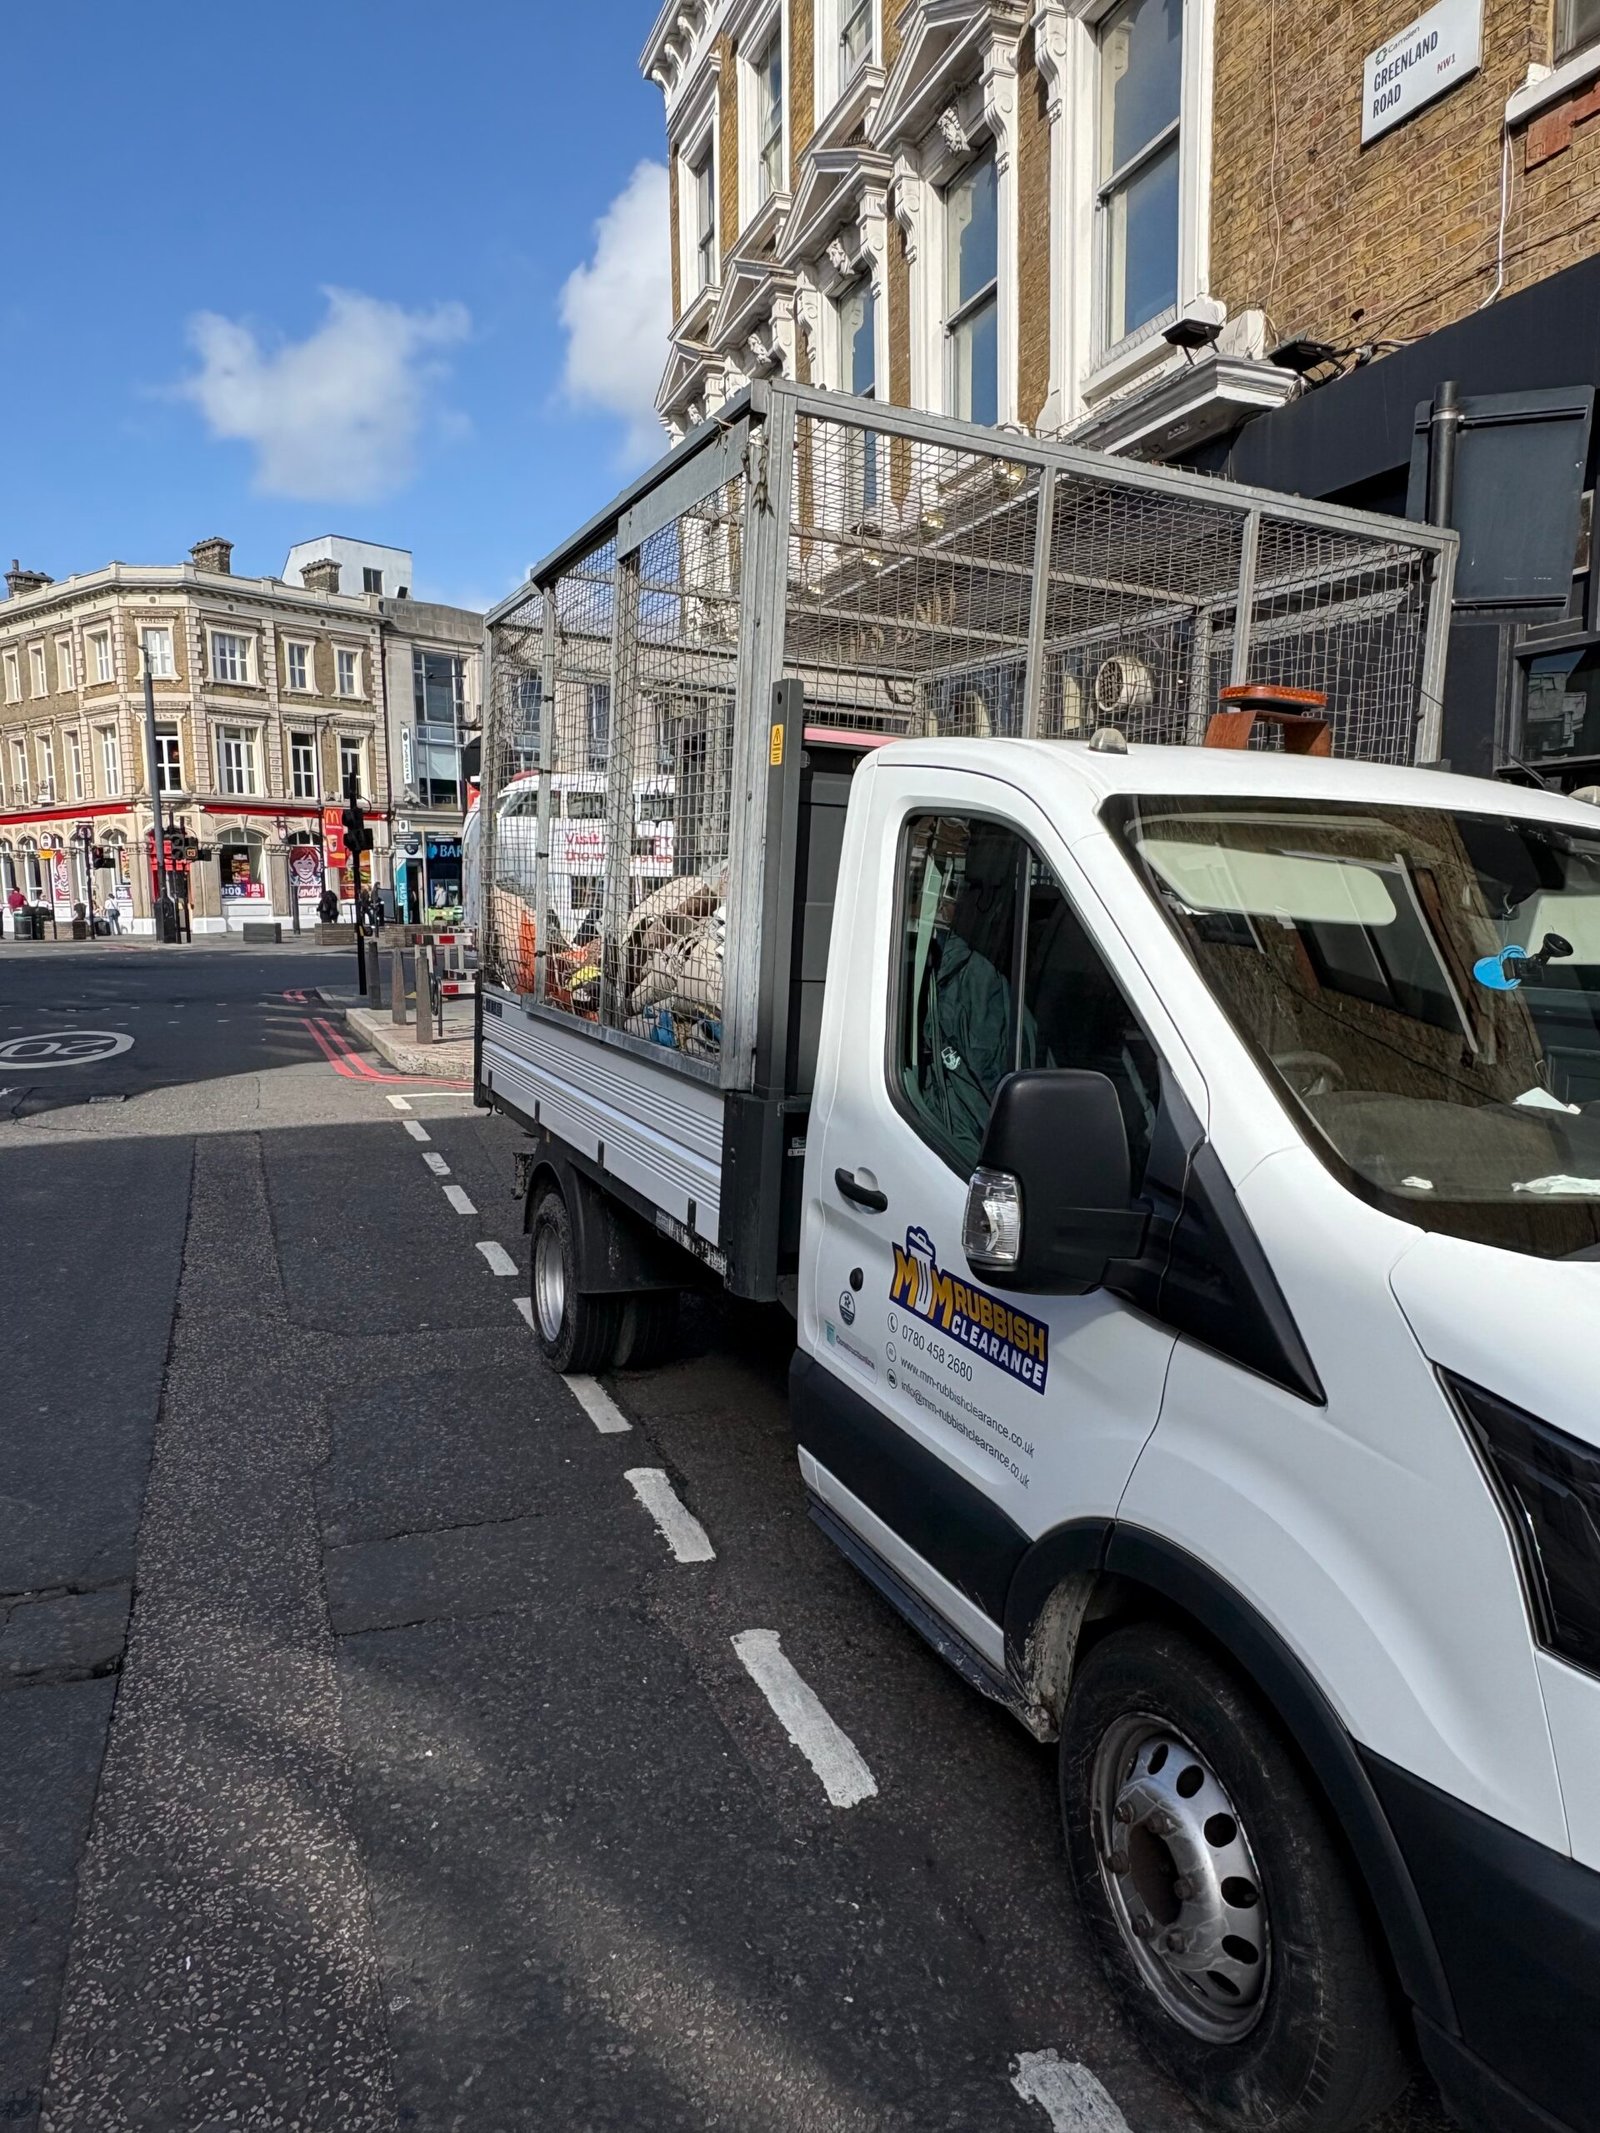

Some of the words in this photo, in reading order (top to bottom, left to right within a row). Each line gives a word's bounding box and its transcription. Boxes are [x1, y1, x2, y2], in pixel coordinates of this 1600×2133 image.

[1373, 30, 1438, 92] GREENLAND
[1388, 26, 1420, 53] Camden
[1436, 53, 1456, 74] NW1
[1373, 83, 1401, 119] ROAD
[1, 1040, 116, 1058] 20
[951, 1314, 1044, 1387] CLEARANCE
[953, 1281, 1045, 1361] RUBBISH
[902, 1325, 925, 1350] 0780
[927, 1341, 945, 1364] 458
[947, 1353, 973, 1381] 2680
[900, 1356, 1035, 1459] www.mm-rubbishclearance.co.uk
[900, 1380, 1030, 1490] info@mm-rubbishclearance.co.uk
